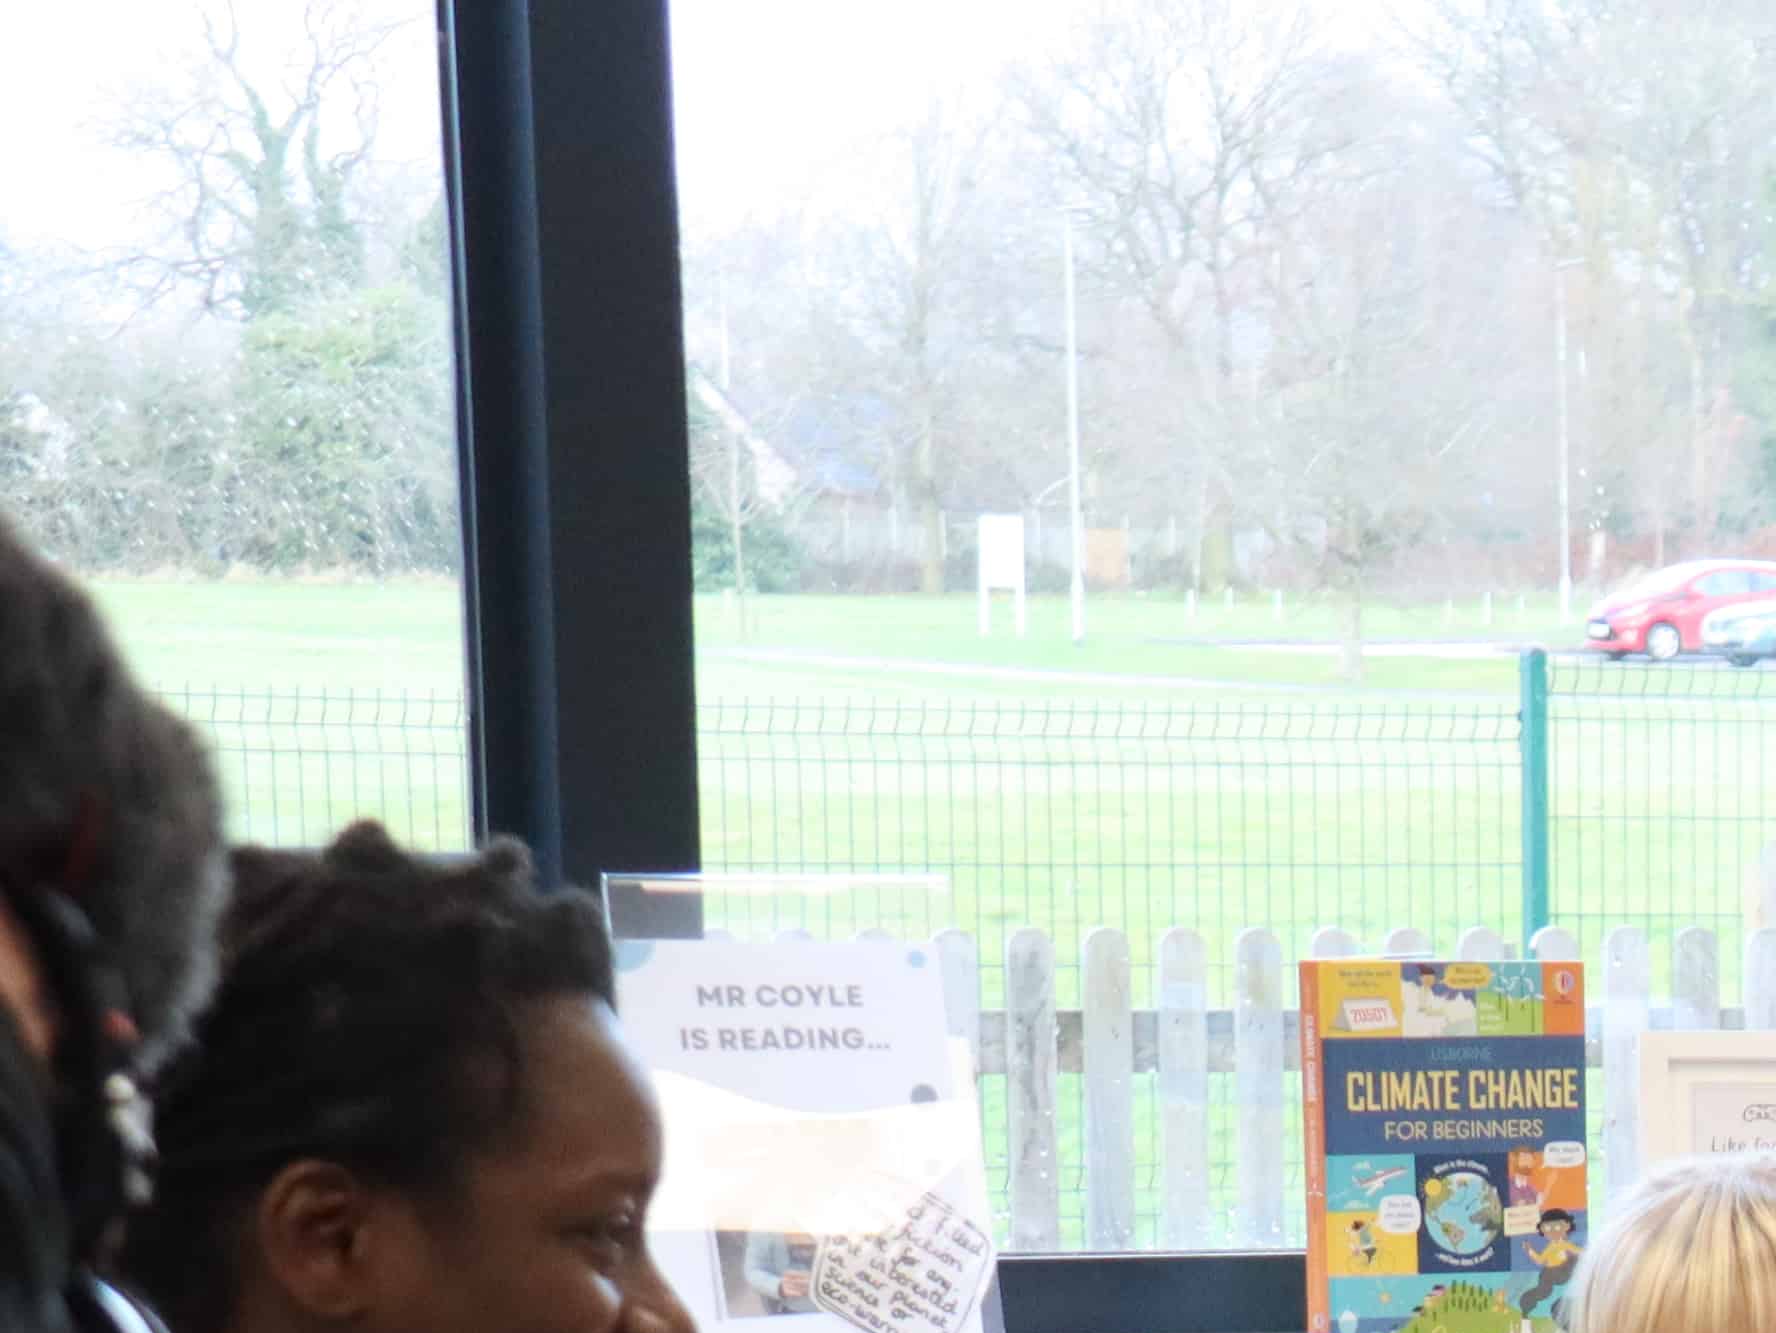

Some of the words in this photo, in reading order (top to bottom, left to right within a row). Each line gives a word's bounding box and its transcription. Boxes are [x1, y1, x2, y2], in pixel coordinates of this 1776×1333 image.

[696, 985, 746, 1007] MR
[755, 984, 865, 1007] COYLE
[679, 1027, 710, 1051] IS
[717, 1026, 891, 1051] READING...
[1346, 1070, 1461, 1112] CLIMATE
[1468, 1068, 1580, 1110] CHANGE
[1384, 1121, 1428, 1140] FOR
[1433, 1118, 1545, 1139] BEGINNERS
